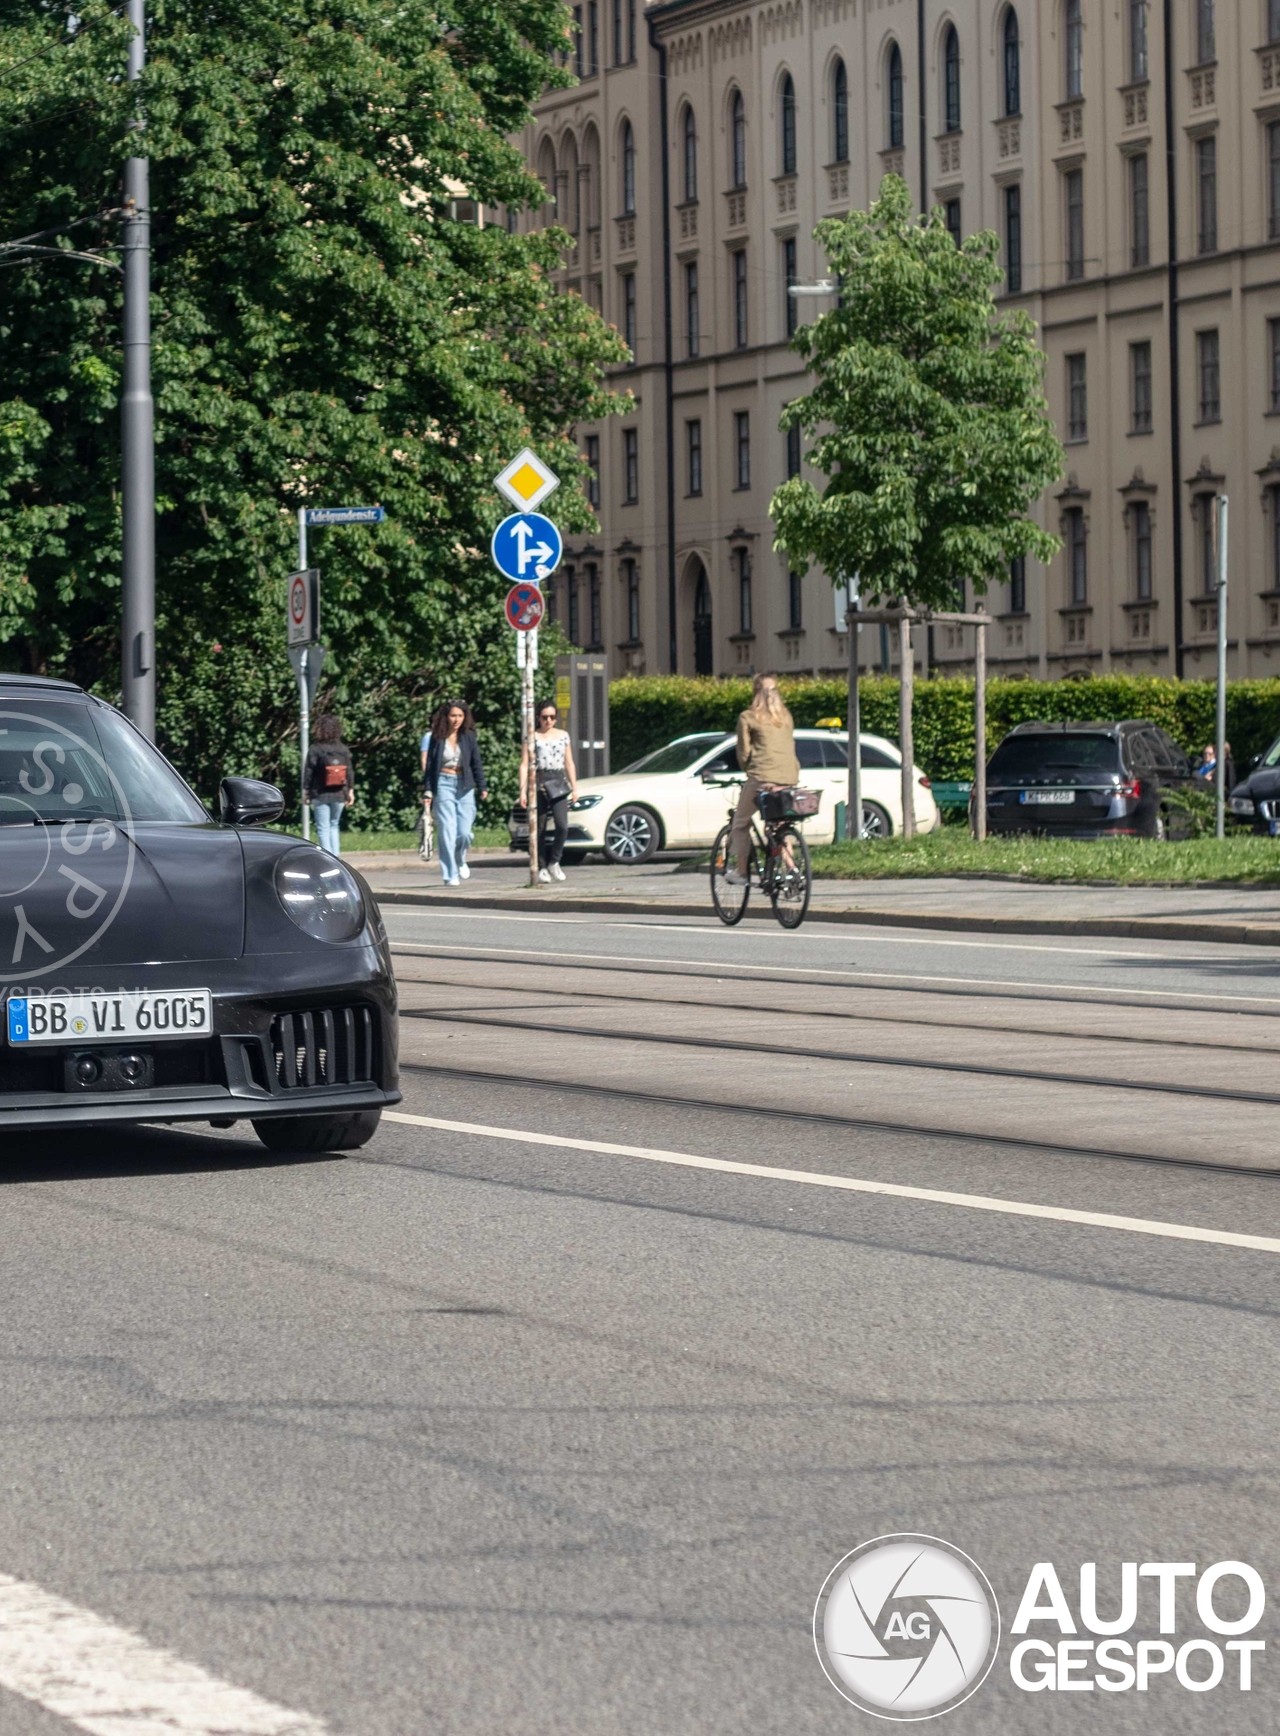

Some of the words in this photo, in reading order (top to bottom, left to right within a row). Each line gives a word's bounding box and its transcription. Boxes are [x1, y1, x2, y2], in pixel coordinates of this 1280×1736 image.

[309, 509, 377, 524] Adelgundenstr.
[16, 1024, 24, 1035] D
[30, 1002, 68, 1035] BB
[91, 1000, 126, 1032] VI
[135, 996, 206, 1030] 6005
